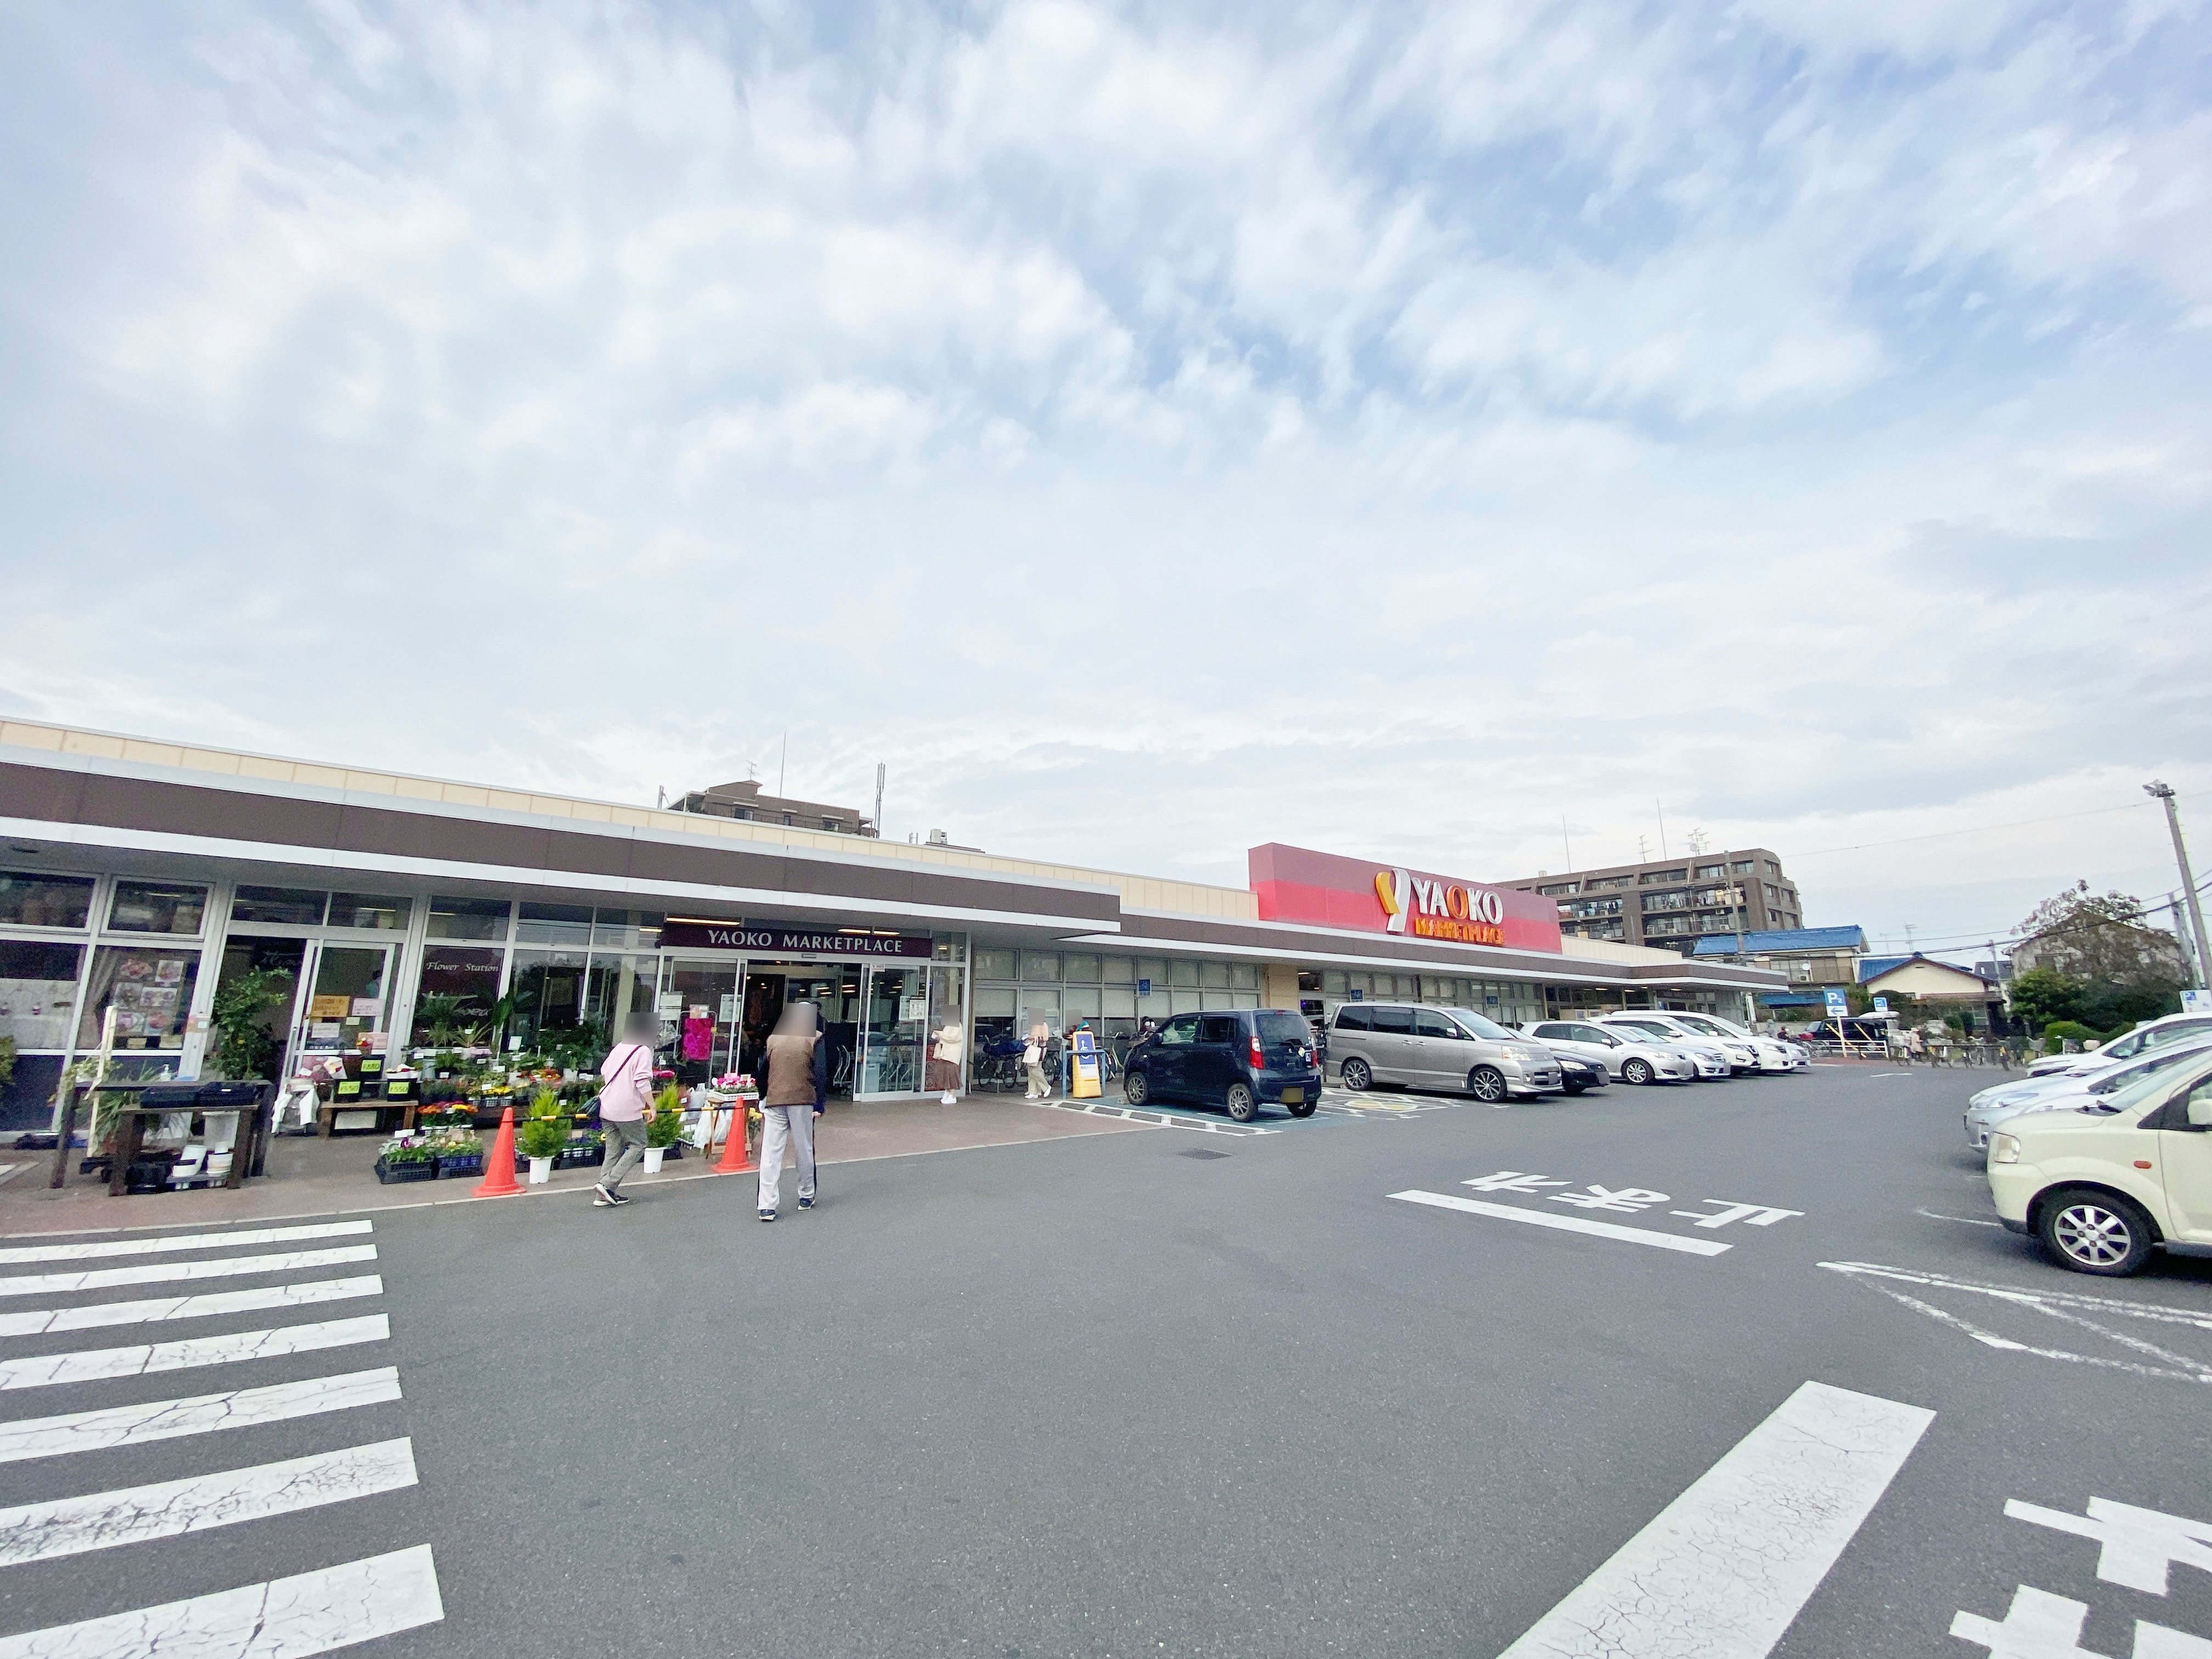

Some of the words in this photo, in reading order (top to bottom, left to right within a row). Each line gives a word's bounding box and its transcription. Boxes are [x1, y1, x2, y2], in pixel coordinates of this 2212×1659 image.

[1411, 877, 1504, 925] YAOKO
[708, 930, 772, 946] YAOKO
[783, 934, 902, 952] MARKETPLACE
[1415, 917, 1505, 945] MARKETPLACE
[427, 961, 460, 970] Flower
[465, 963, 498, 972] Station
[1460, 1171, 1805, 1229] 止まれ
